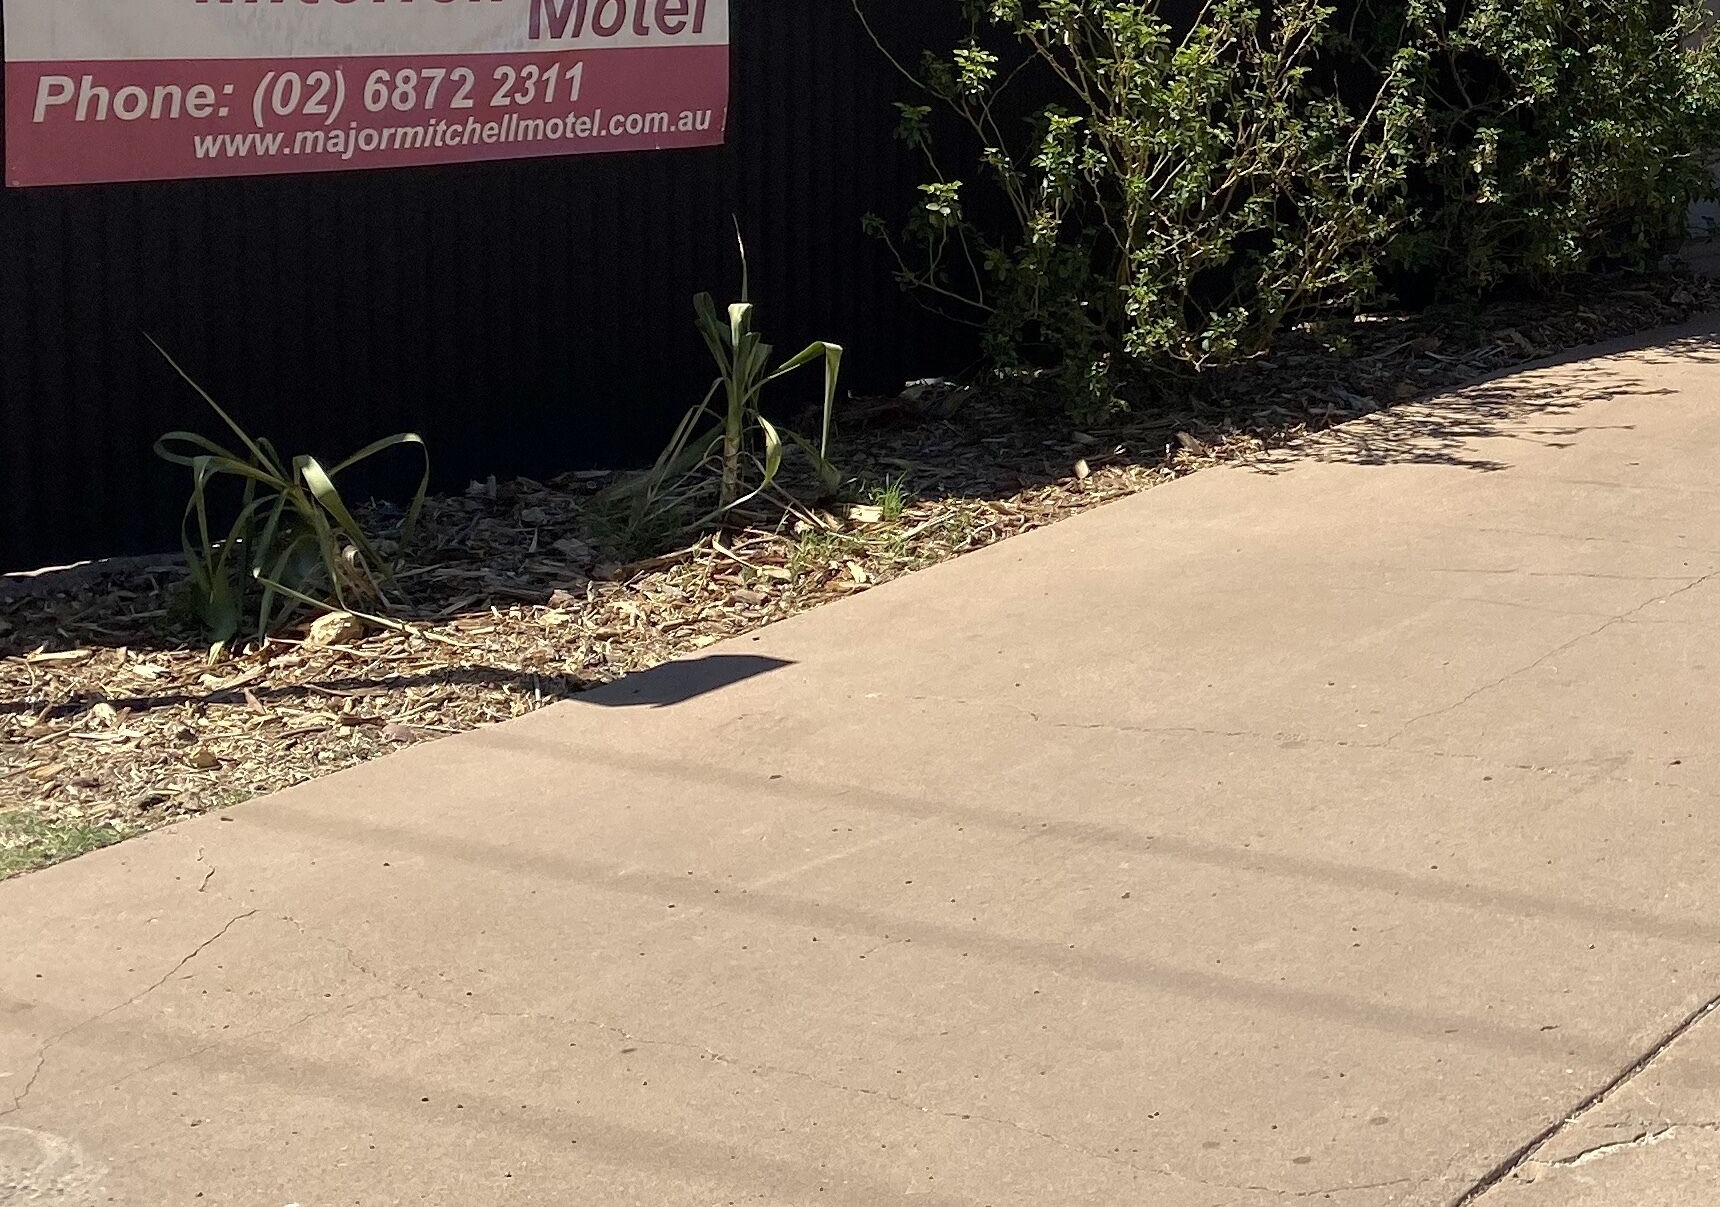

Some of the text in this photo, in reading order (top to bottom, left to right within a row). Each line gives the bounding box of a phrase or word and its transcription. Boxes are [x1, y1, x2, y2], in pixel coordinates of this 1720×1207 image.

[32, 62, 585, 127] Phone: (02) 6872 2311
[193, 106, 712, 160] www.majormitchellmotel.com.au
